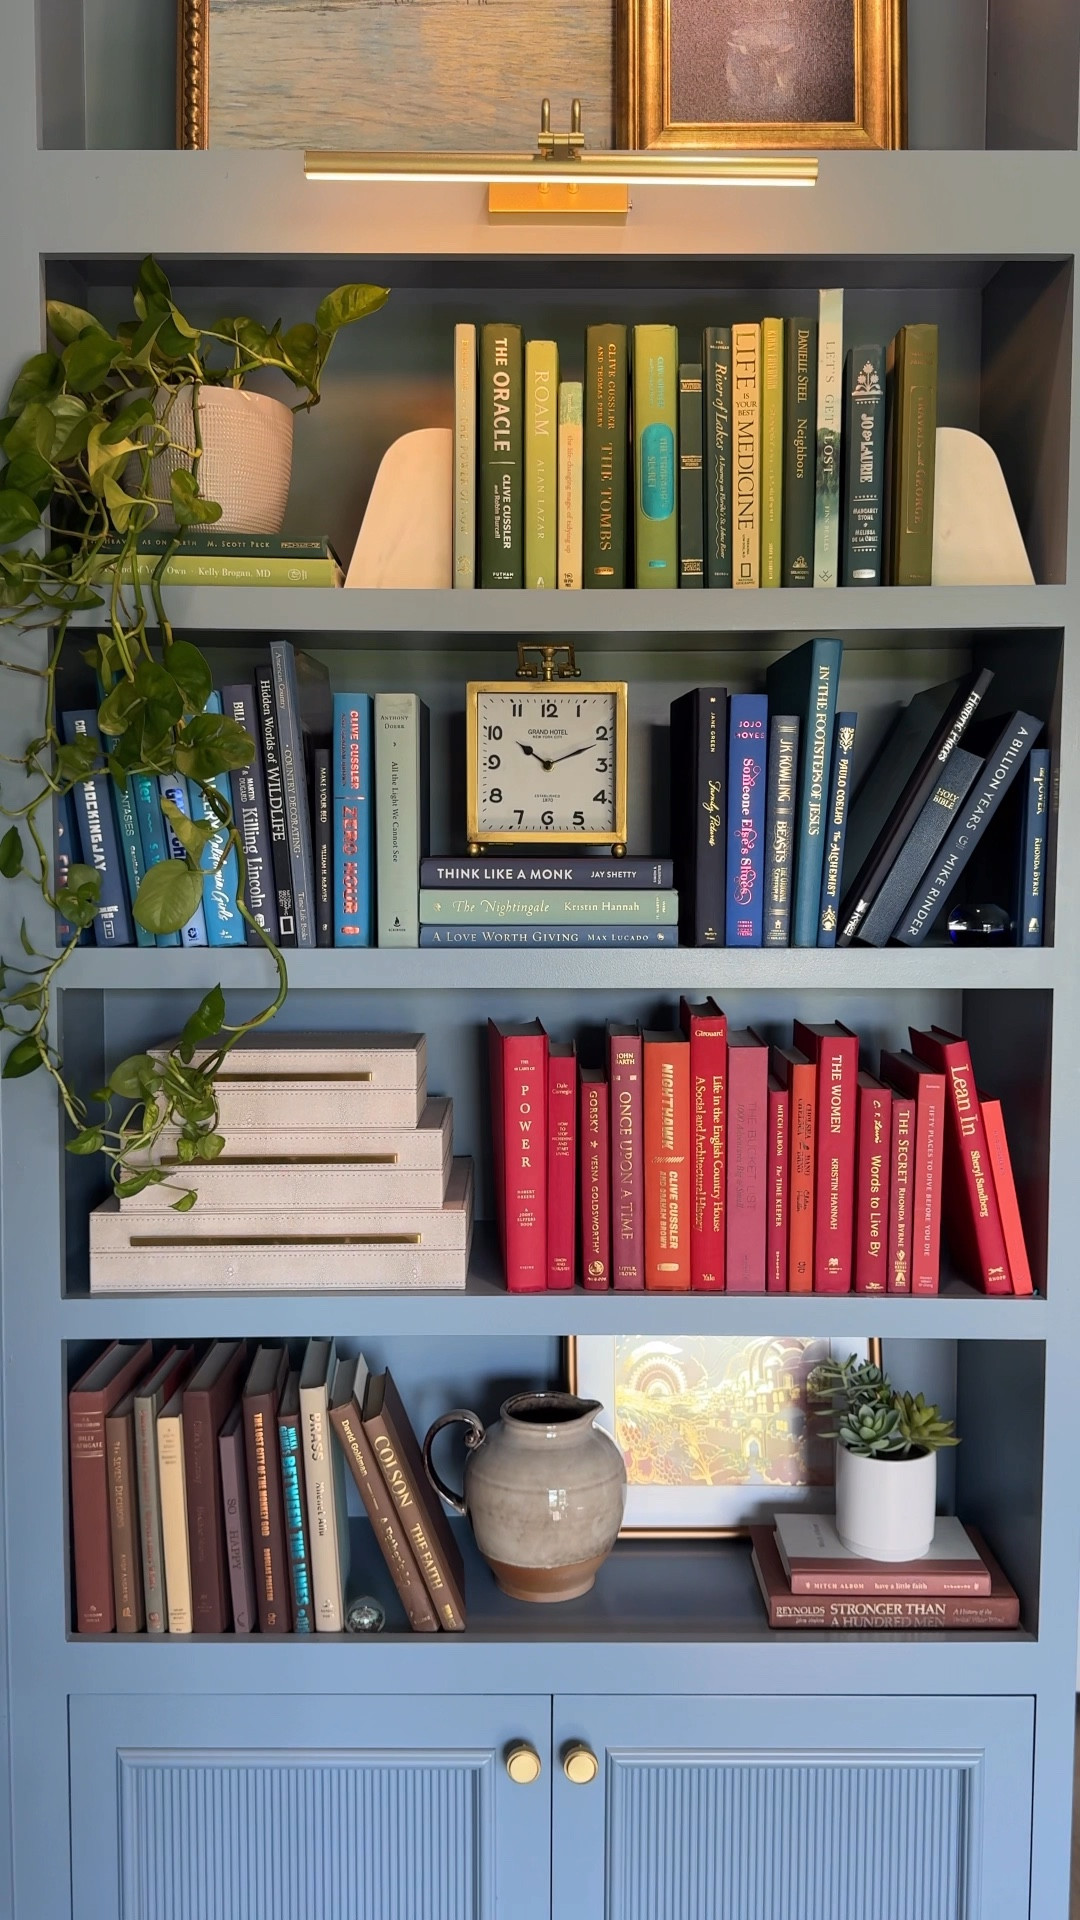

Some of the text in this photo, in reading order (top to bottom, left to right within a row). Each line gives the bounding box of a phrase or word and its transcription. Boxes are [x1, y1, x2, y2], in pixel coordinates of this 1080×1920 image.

[608, 344, 617, 430] CLIVE CUSSLER
[715, 362, 727, 397] River
[736, 332, 756, 389] LIFE
[797, 330, 809, 403] DANIELLE STEEL
[493, 338, 511, 452] THE ORACLE
[534, 370, 550, 436] ROAM
[713, 398, 727, 413] of
[823, 341, 836, 475] LET'S GET LOST
[715, 413, 728, 451] Lakes
[793, 418, 807, 480] Neighbors
[600, 442, 613, 551] THE TOMBS
[738, 422, 755, 531] MEDICINE
[502, 474, 512, 549] CLIVE CUSSLER
[167, 565, 186, 575] Own
[380, 714, 409, 722] ANTHONY
[488, 725, 608, 741] 10 2
[512, 704, 581, 717] 11 12 1
[739, 721, 762, 729] JOJO
[260, 679, 286, 843] Hidden Worlds of WILDLIFE
[350, 710, 360, 790] CLIVE CUSSLER
[488, 754, 608, 772] 9 3
[777, 738, 793, 802] JK ROWLING
[808, 665, 830, 836] IN THE FOOTSTEPS OF JESUS
[964, 726, 1028, 832] A BILLION YEARS
[284, 748, 301, 854] COUNTRY DECORATING
[489, 788, 607, 804] 8 4
[513, 810, 585, 826] 7 6 5
[834, 758, 849, 826] PAULO COELHO
[932, 794, 956, 811] BIBLE
[935, 787, 961, 802] HOLY
[82, 781, 107, 873] MOCKINGJAY
[241, 807, 263, 909] Killing Lincoln
[342, 805, 358, 914] ZERO HOUR
[775, 820, 788, 864] BEASTS
[436, 868, 573, 880] THINK LIKE A MONK
[591, 871, 637, 879] JAY SHETTY
[907, 853, 959, 937] MIKE RINDER
[1032, 837, 1043, 898] RHONDA BYRNE
[432, 931, 578, 942] A LOVE WORTH GIVING
[452, 899, 550, 917] The Nightingale
[564, 901, 640, 911] Kristin Hannah
[695, 1030, 723, 1038] Girouard
[519, 1085, 533, 1168] POWER
[589, 1090, 598, 1133] GORSKY
[661, 1063, 673, 1151] NIGHTHAWK
[776, 1104, 784, 1127] MITCH
[830, 1054, 842, 1135] THE WOMEN
[950, 1063, 978, 1137] Lean In
[619, 1091, 633, 1241] ONCE UPON A TIME
[896, 1110, 910, 1184] THE SECRET
[590, 1154, 599, 1255] VESNA GOLDSWORTHY
[669, 1170, 679, 1250] CLIVE CUSSLER
[829, 1158, 838, 1231] KRISTIN HANNAH
[867, 1155, 882, 1258] Words to Live By
[970, 1150, 989, 1219] Sheryl Sandberg
[702, 1273, 715, 1282] Yale
[310, 1412, 325, 1462] BRASS
[341, 1419, 369, 1478] David Goldman
[374, 1435, 414, 1509] COLSON
[227, 1498, 242, 1571] SO HAPPY
[283, 1455, 310, 1607] BETWEEN THE LINES
[410, 1522, 445, 1592] THE FAITH
[776, 1606, 825, 1615] REYNOLDS
[830, 1603, 947, 1615] STRONGER THAN
[874, 1582, 890, 1591] have
[896, 1582, 911, 1590] little
[911, 1582, 928, 1591] faith
[831, 1616, 945, 1627] A HUNDRED MEN
